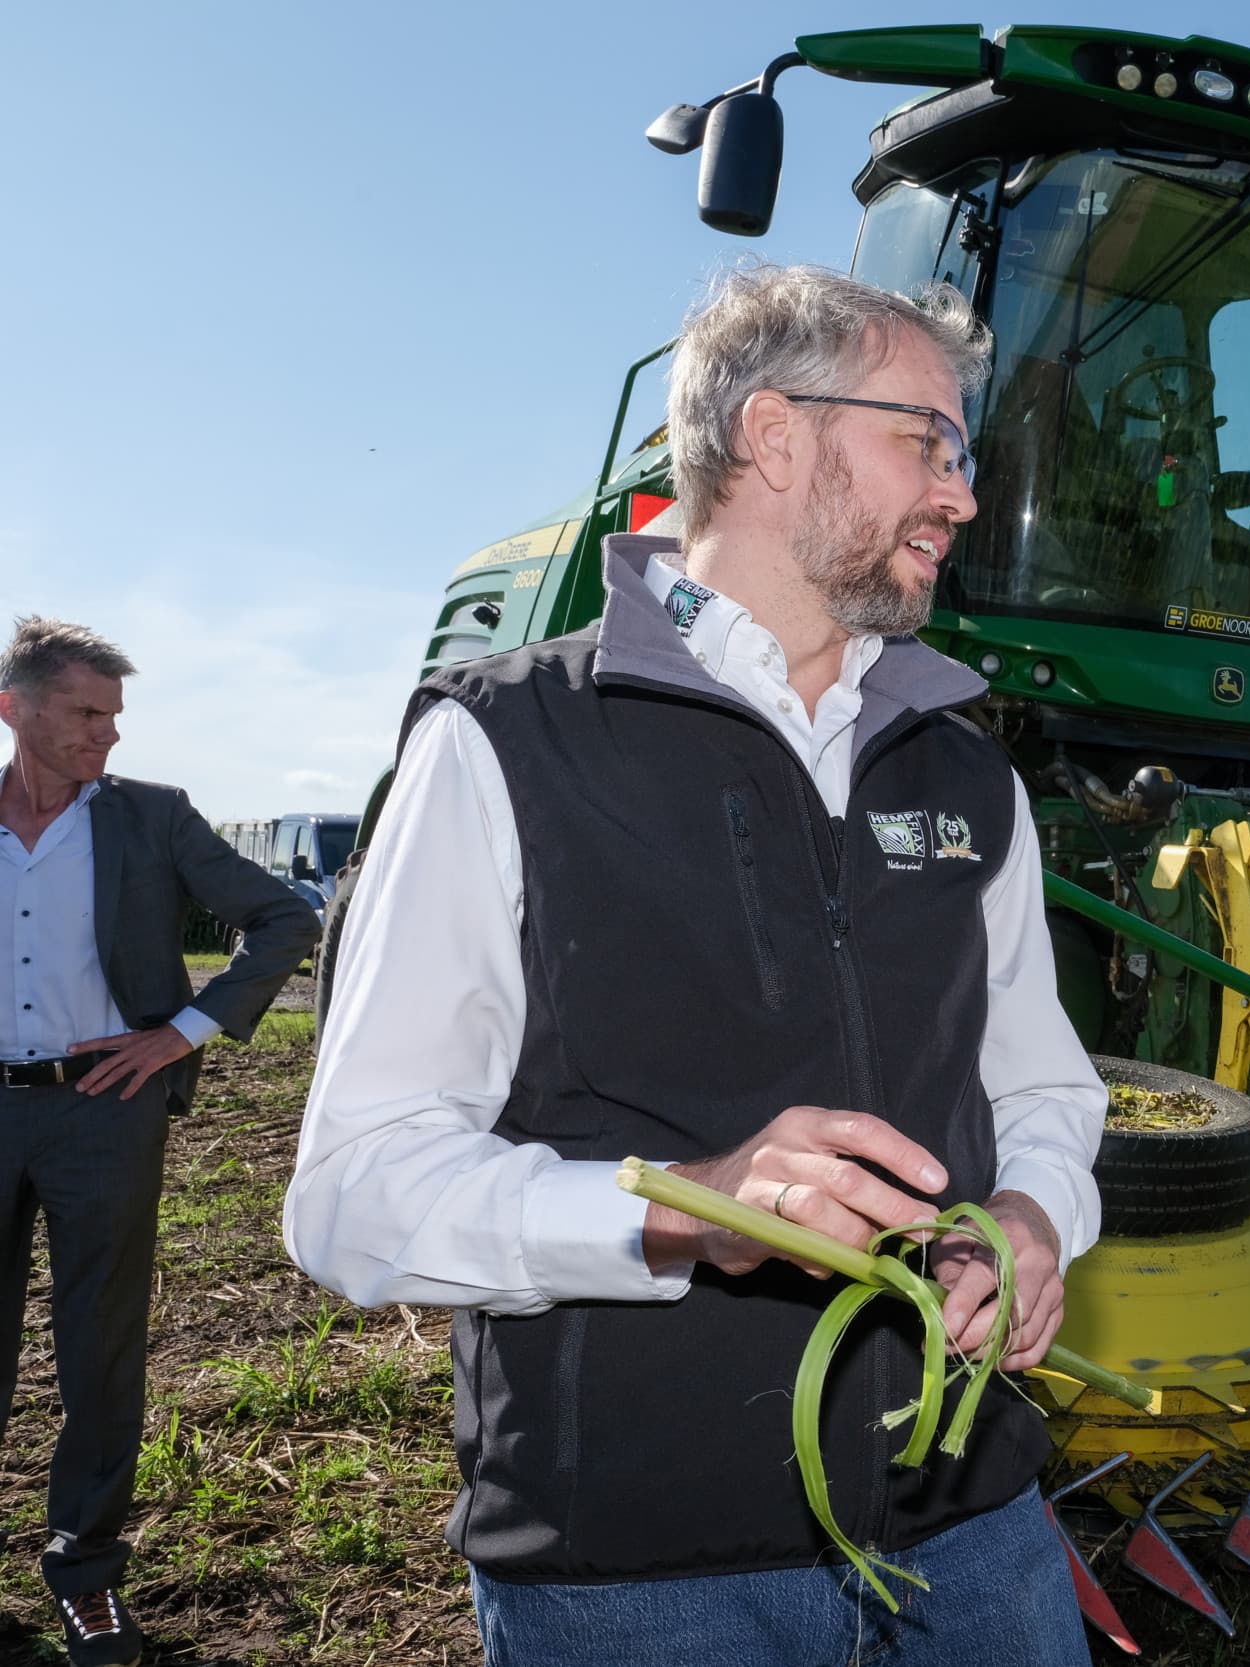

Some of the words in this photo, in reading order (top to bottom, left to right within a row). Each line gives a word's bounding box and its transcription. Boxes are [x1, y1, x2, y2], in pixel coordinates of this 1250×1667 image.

[676, 579, 712, 599] HEMP
[683, 599, 706, 626] FLAX
[870, 813, 914, 824] HEMP
[945, 819, 959, 832] 25
[907, 821, 924, 853] FLAX
